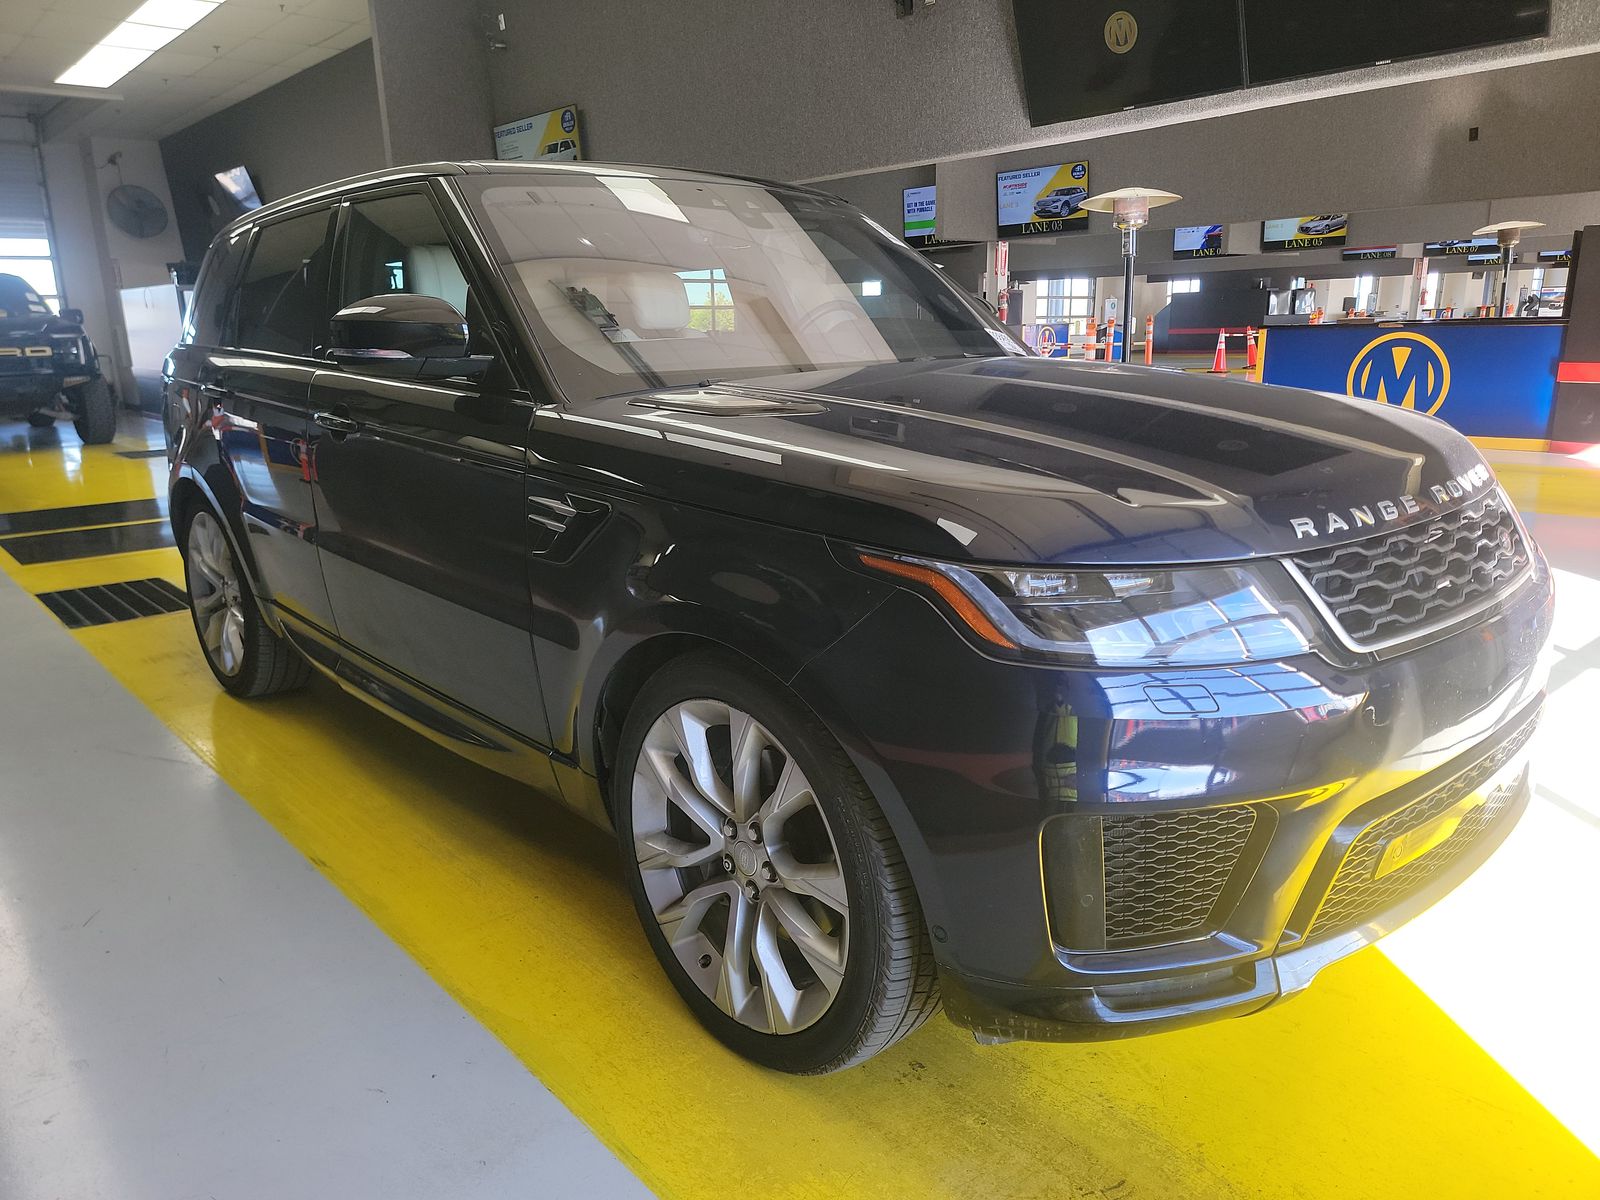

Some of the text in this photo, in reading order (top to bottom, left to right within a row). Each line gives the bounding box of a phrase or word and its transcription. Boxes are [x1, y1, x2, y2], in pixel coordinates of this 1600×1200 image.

[495, 122, 533, 139] FEATURED SELLER
[999, 170, 1041, 182] FEATURED SELLER
[1022, 220, 1063, 234] LANE 03
[1284, 237, 1323, 248] LANE 05
[1193, 248, 1216, 257] LANE
[1445, 245, 1479, 254] LANE 07
[1360, 251, 1383, 260] LANE
[1290, 463, 1490, 539] RANGE ROVER
